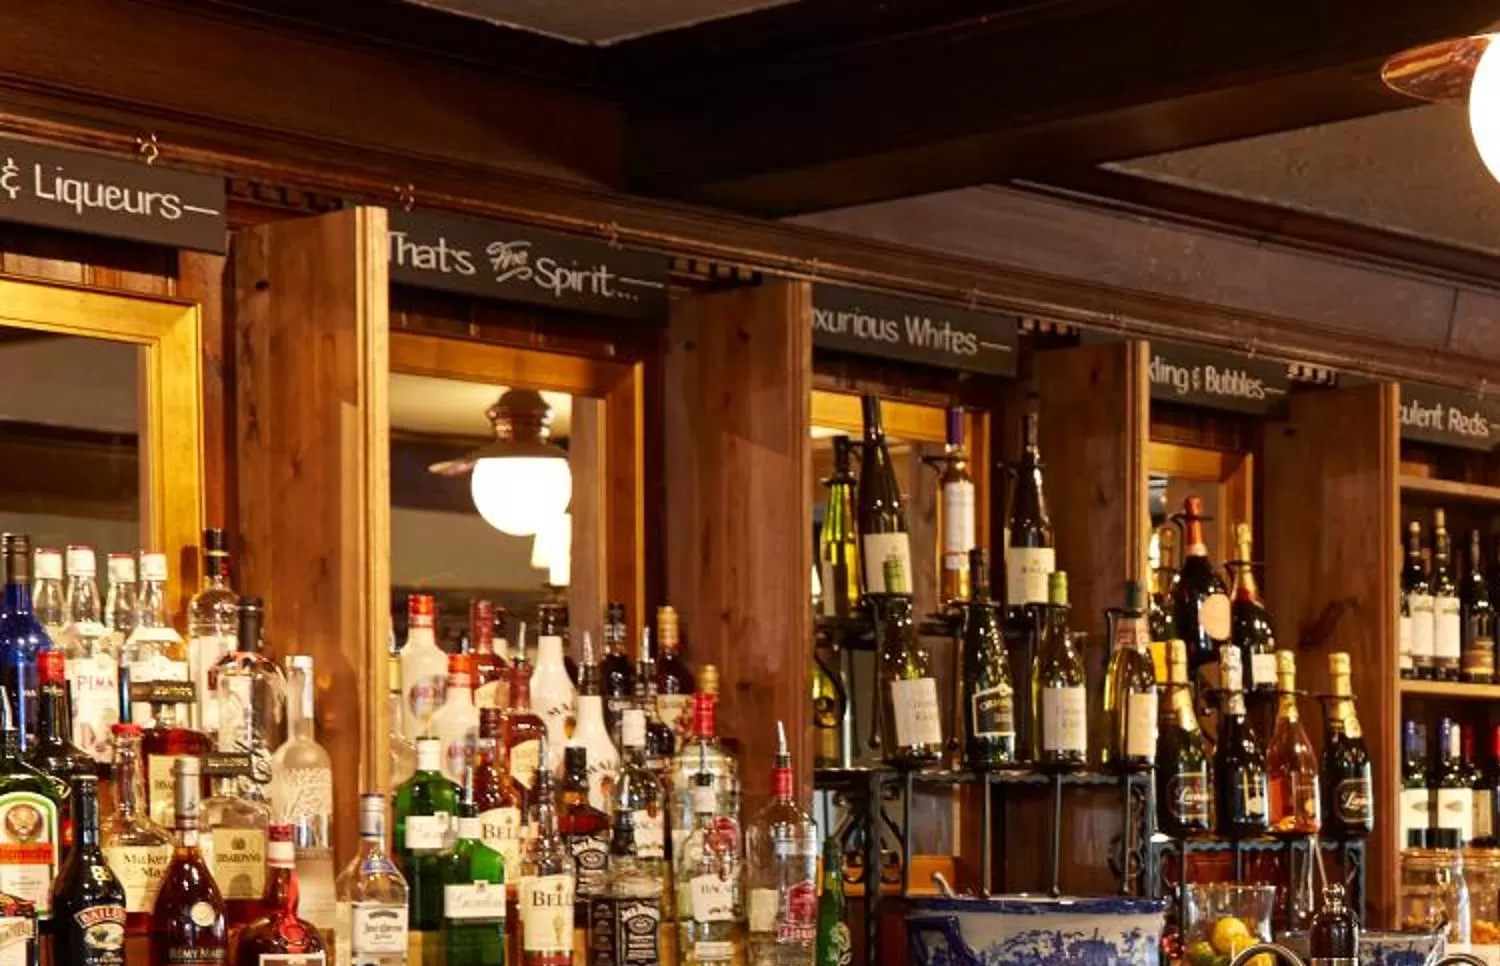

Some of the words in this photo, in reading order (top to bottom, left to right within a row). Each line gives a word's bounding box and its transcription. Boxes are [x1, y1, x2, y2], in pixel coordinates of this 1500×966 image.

[34, 163, 183, 220] Liqueurs
[811, 307, 900, 343] xurious
[903, 315, 978, 356] Whites
[1204, 365, 1265, 400] Bubbles
[1448, 406, 1490, 438] Reds
